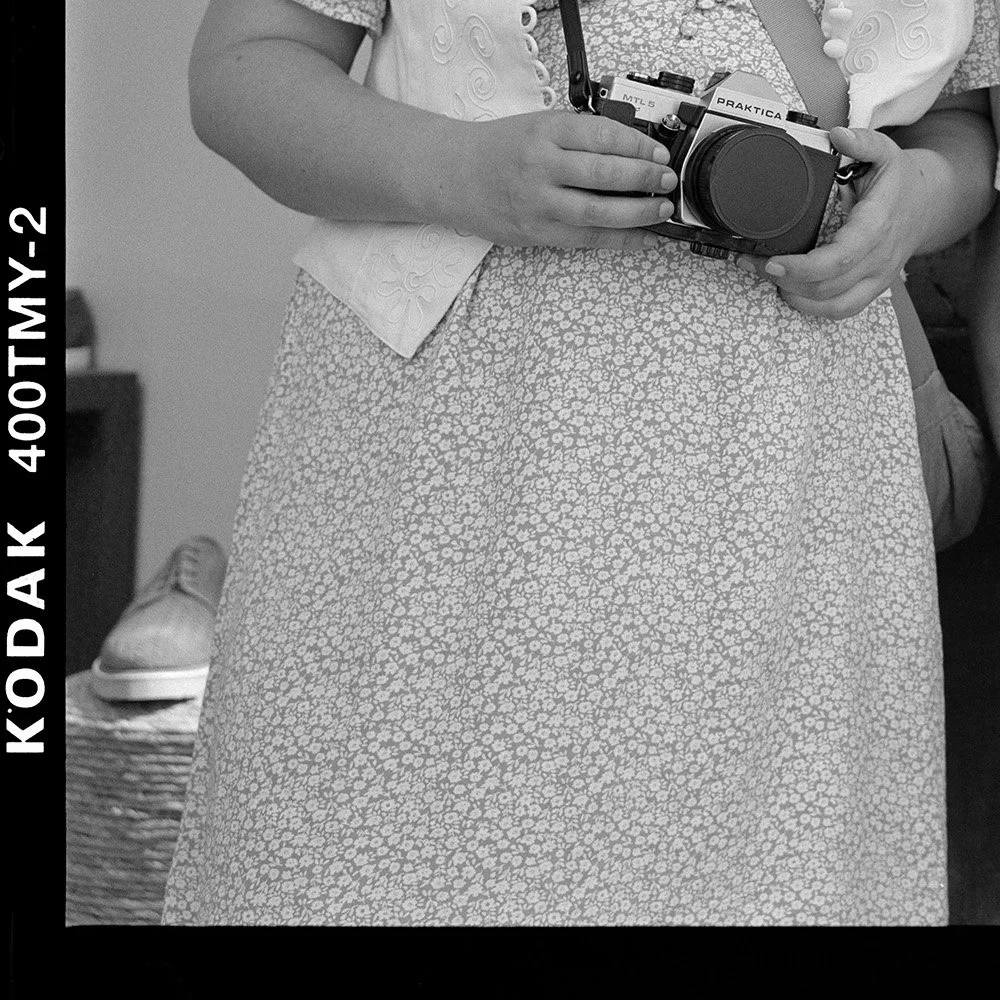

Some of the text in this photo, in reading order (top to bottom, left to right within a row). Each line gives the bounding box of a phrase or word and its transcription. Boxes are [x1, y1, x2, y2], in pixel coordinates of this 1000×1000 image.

[716, 97, 782, 121] PRAKTICA
[5, 206, 46, 753] KODAK 400TMY-2
